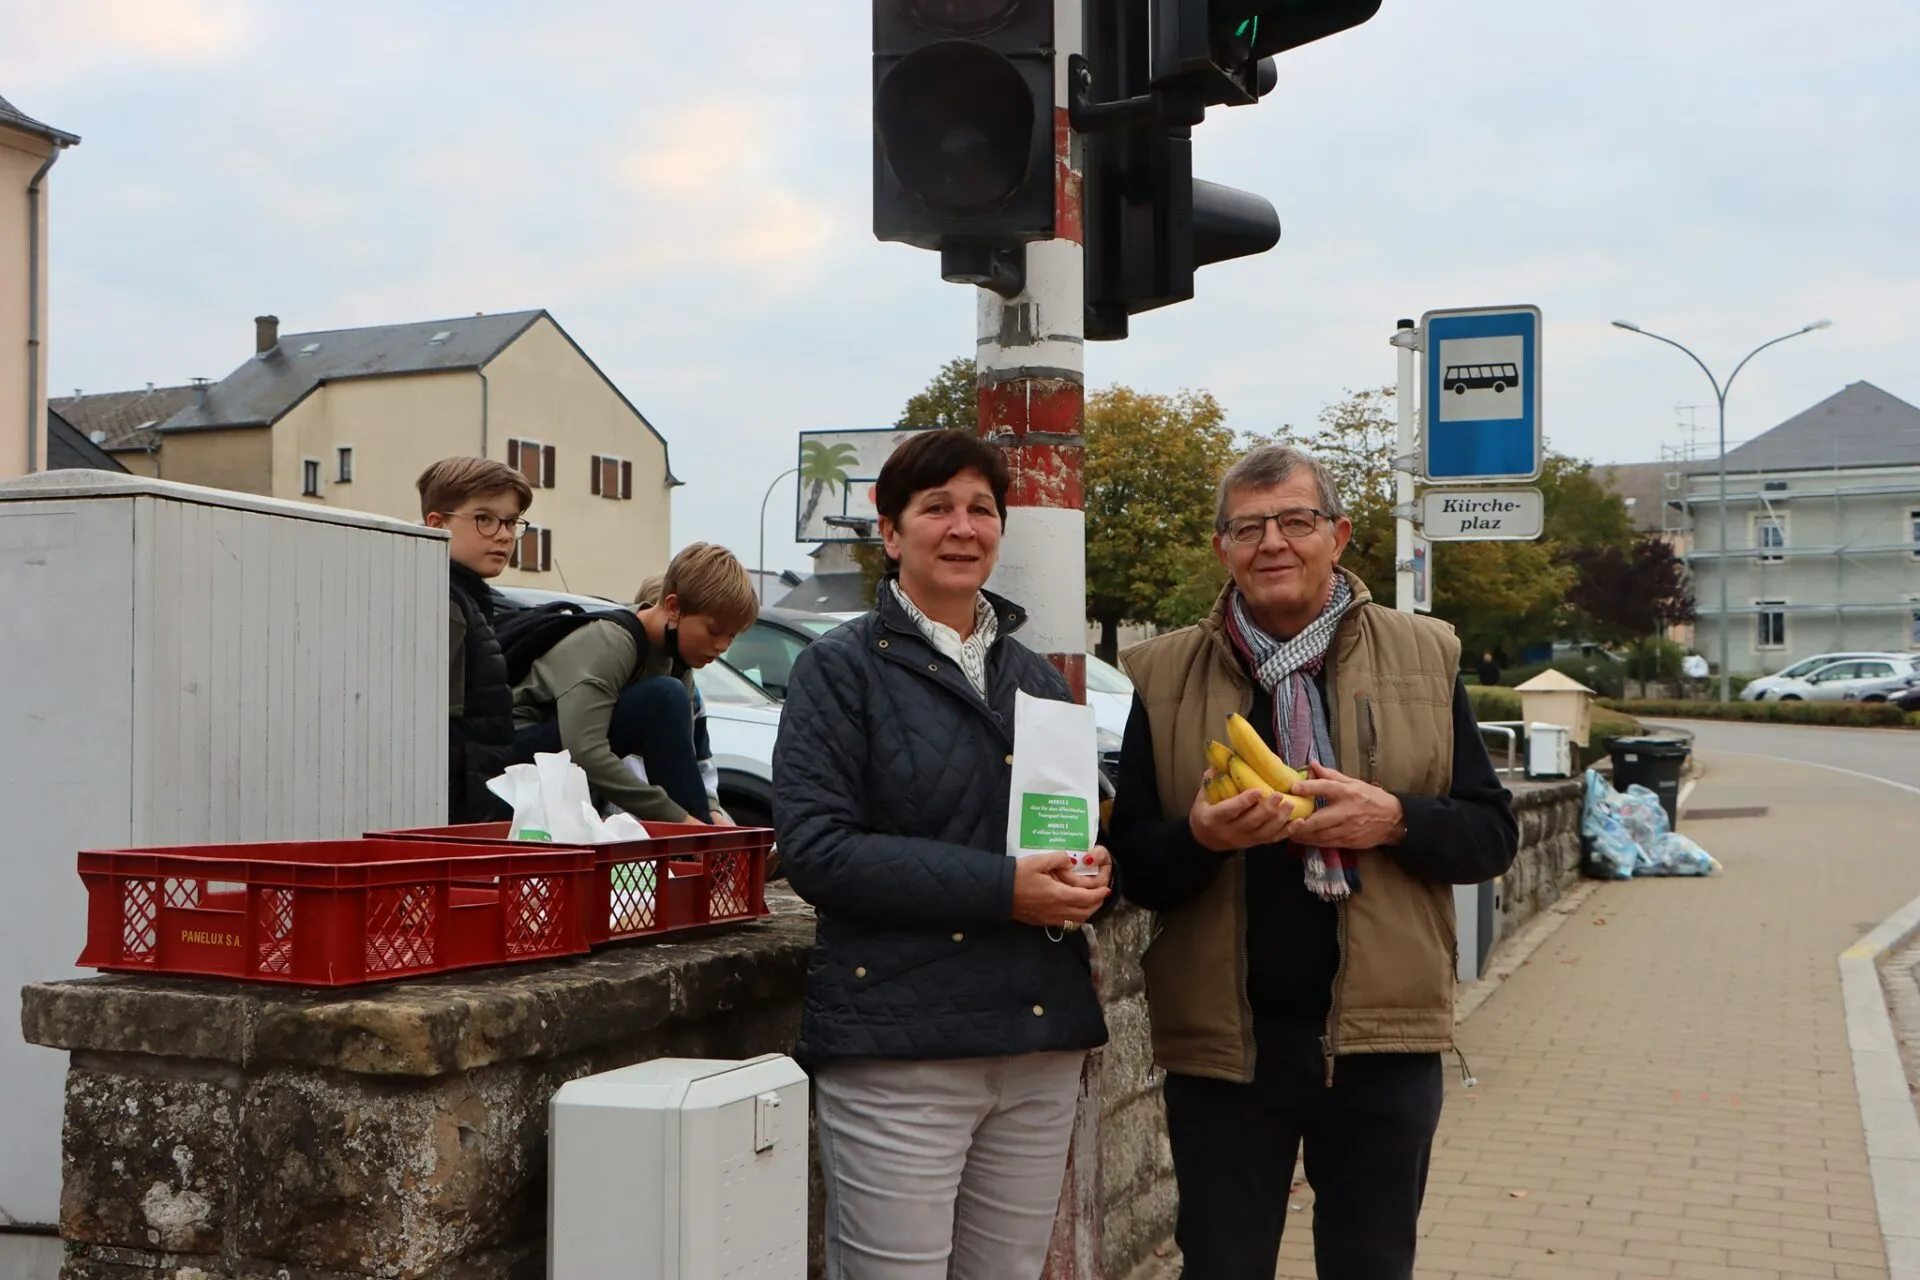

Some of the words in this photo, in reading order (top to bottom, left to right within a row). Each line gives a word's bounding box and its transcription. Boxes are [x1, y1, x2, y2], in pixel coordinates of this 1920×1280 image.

[1442, 498, 1521, 513] Kiirche-
[1460, 516, 1502, 533] plaz
[181, 930, 224, 945] PANELUX
